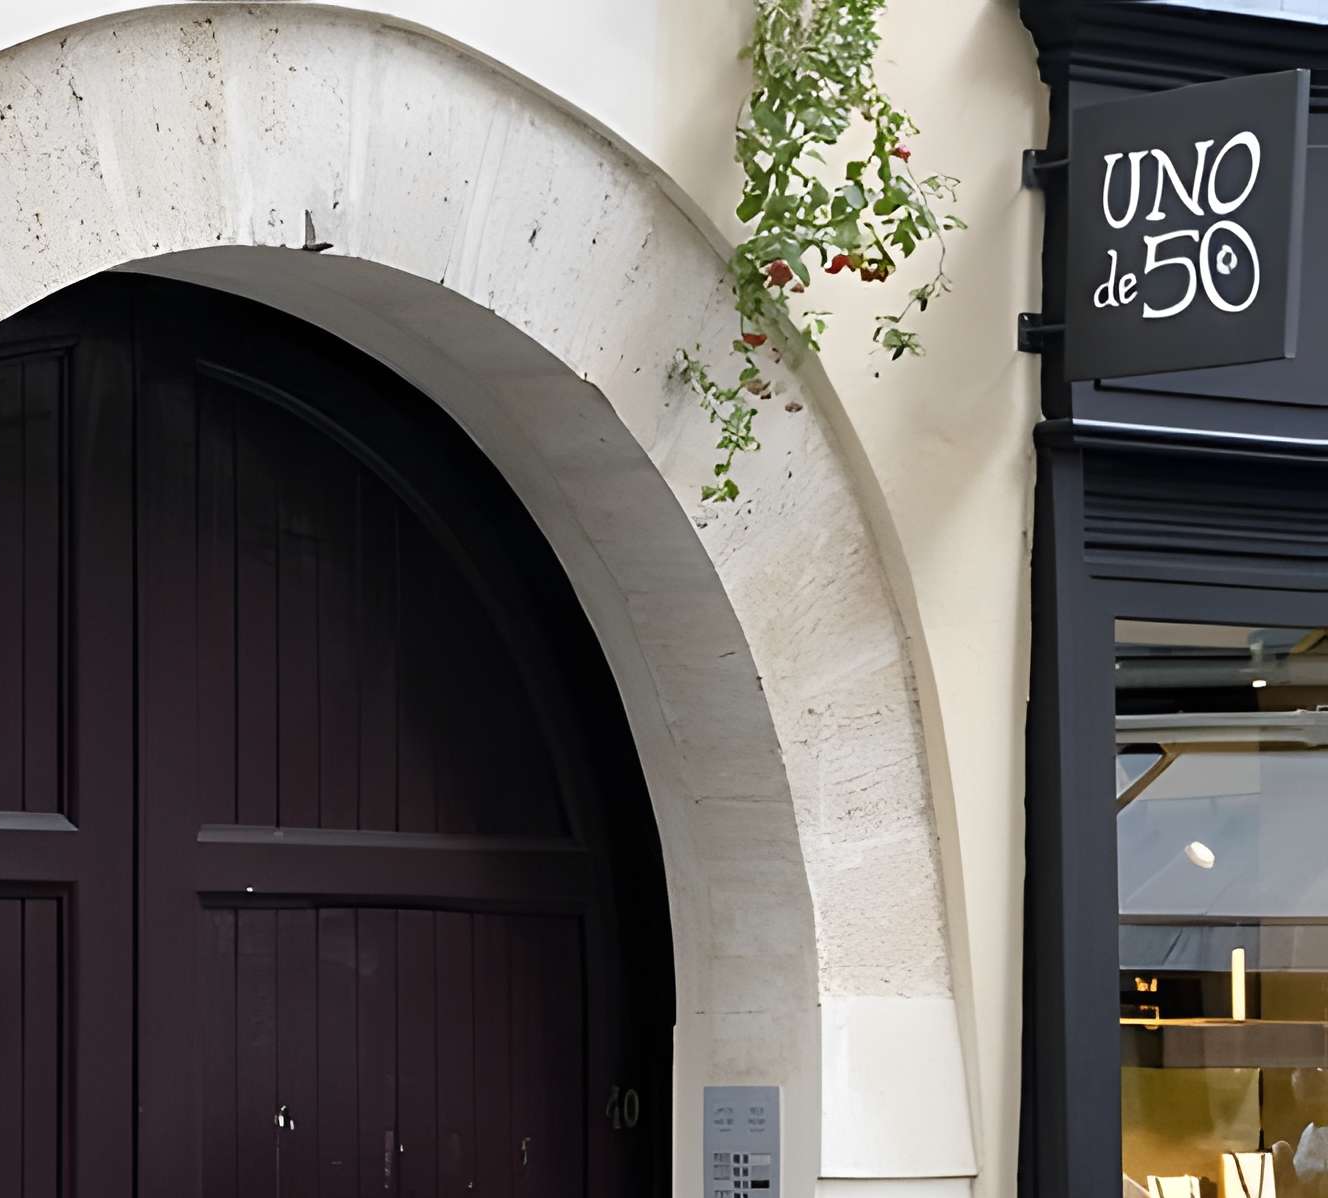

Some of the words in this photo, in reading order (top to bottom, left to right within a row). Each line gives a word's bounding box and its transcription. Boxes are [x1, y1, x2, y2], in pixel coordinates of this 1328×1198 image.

[1102, 130, 1261, 229] UNO
[1093, 249, 1139, 308] de
[1142, 220, 1260, 319] 50
